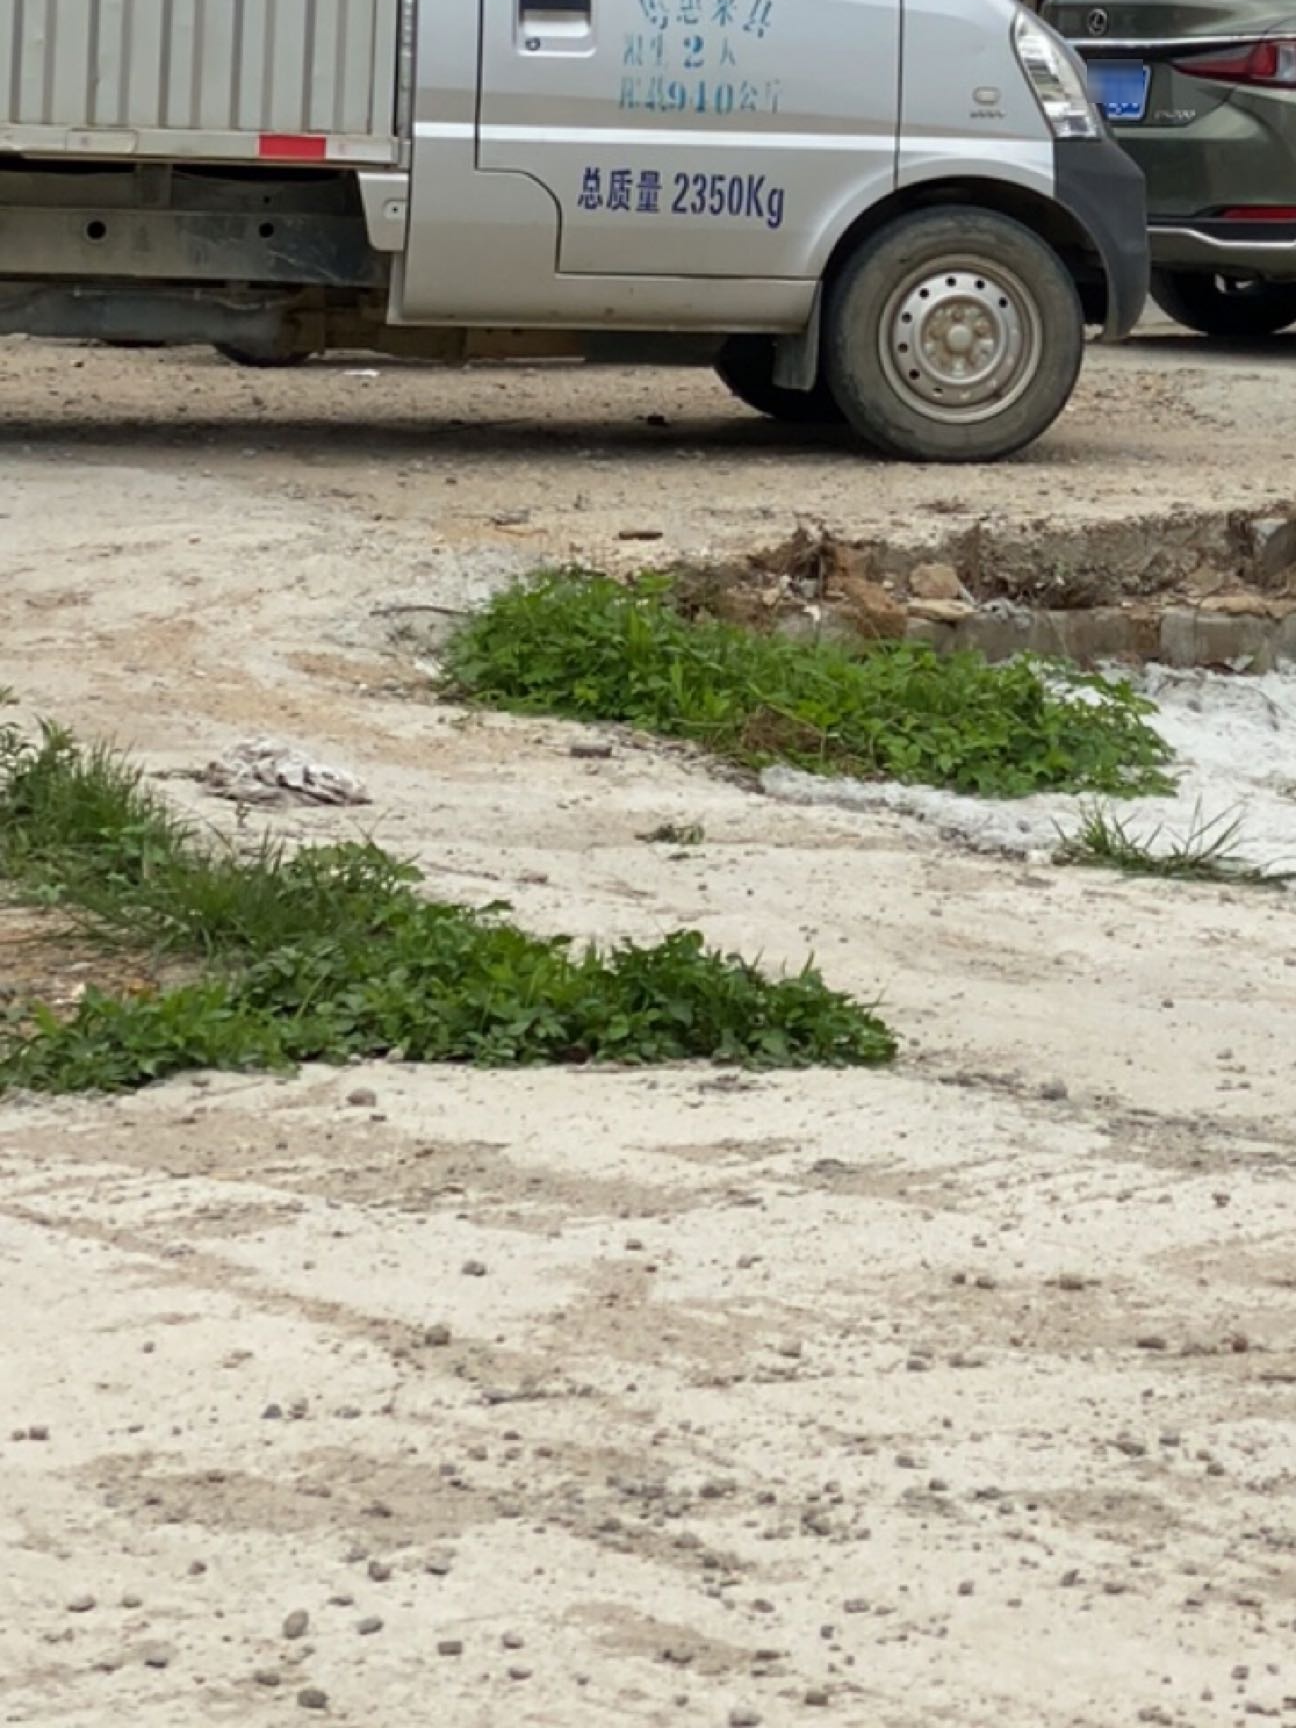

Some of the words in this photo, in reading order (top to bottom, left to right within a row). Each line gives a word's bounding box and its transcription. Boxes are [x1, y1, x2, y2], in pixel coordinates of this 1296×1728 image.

[577, 166, 663, 214] 总质量
[671, 172, 785, 229] 2350Kg
